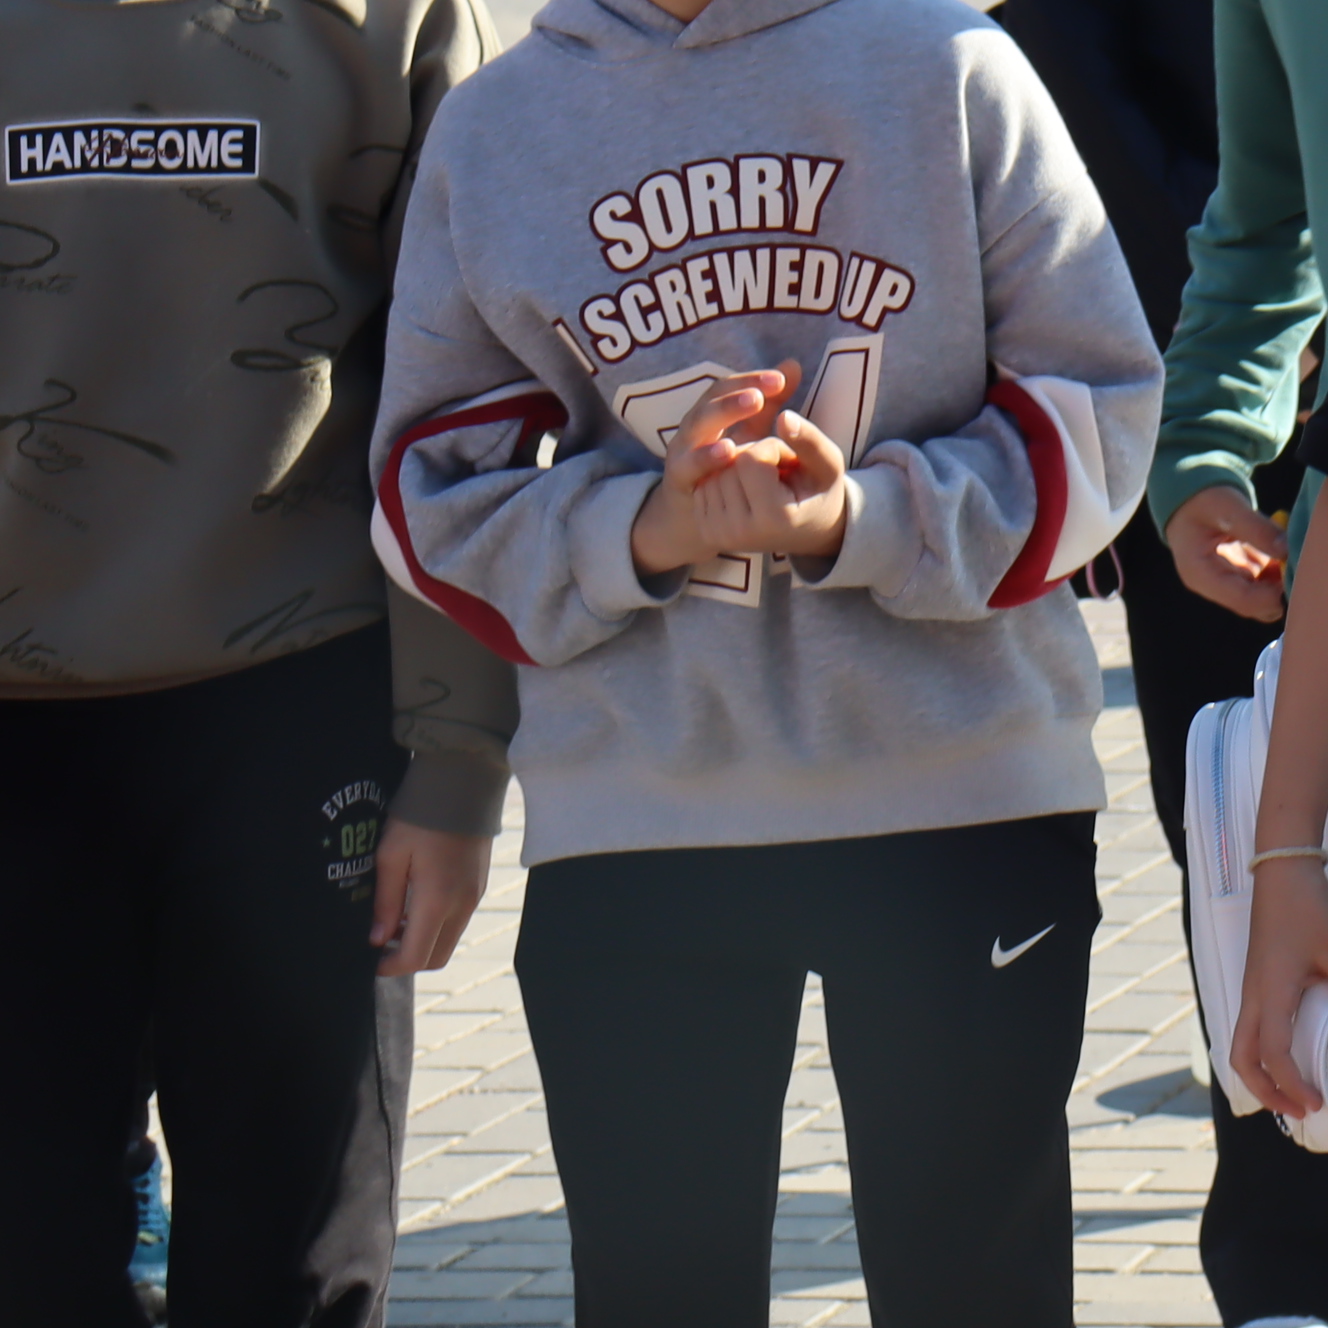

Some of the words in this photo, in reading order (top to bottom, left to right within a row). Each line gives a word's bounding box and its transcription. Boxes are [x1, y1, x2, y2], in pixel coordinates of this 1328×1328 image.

[19, 129, 245, 173] HANDSOME
[589, 152, 844, 274] SORRY
[580, 242, 843, 365] SCREWED
[838, 251, 915, 332] UP
